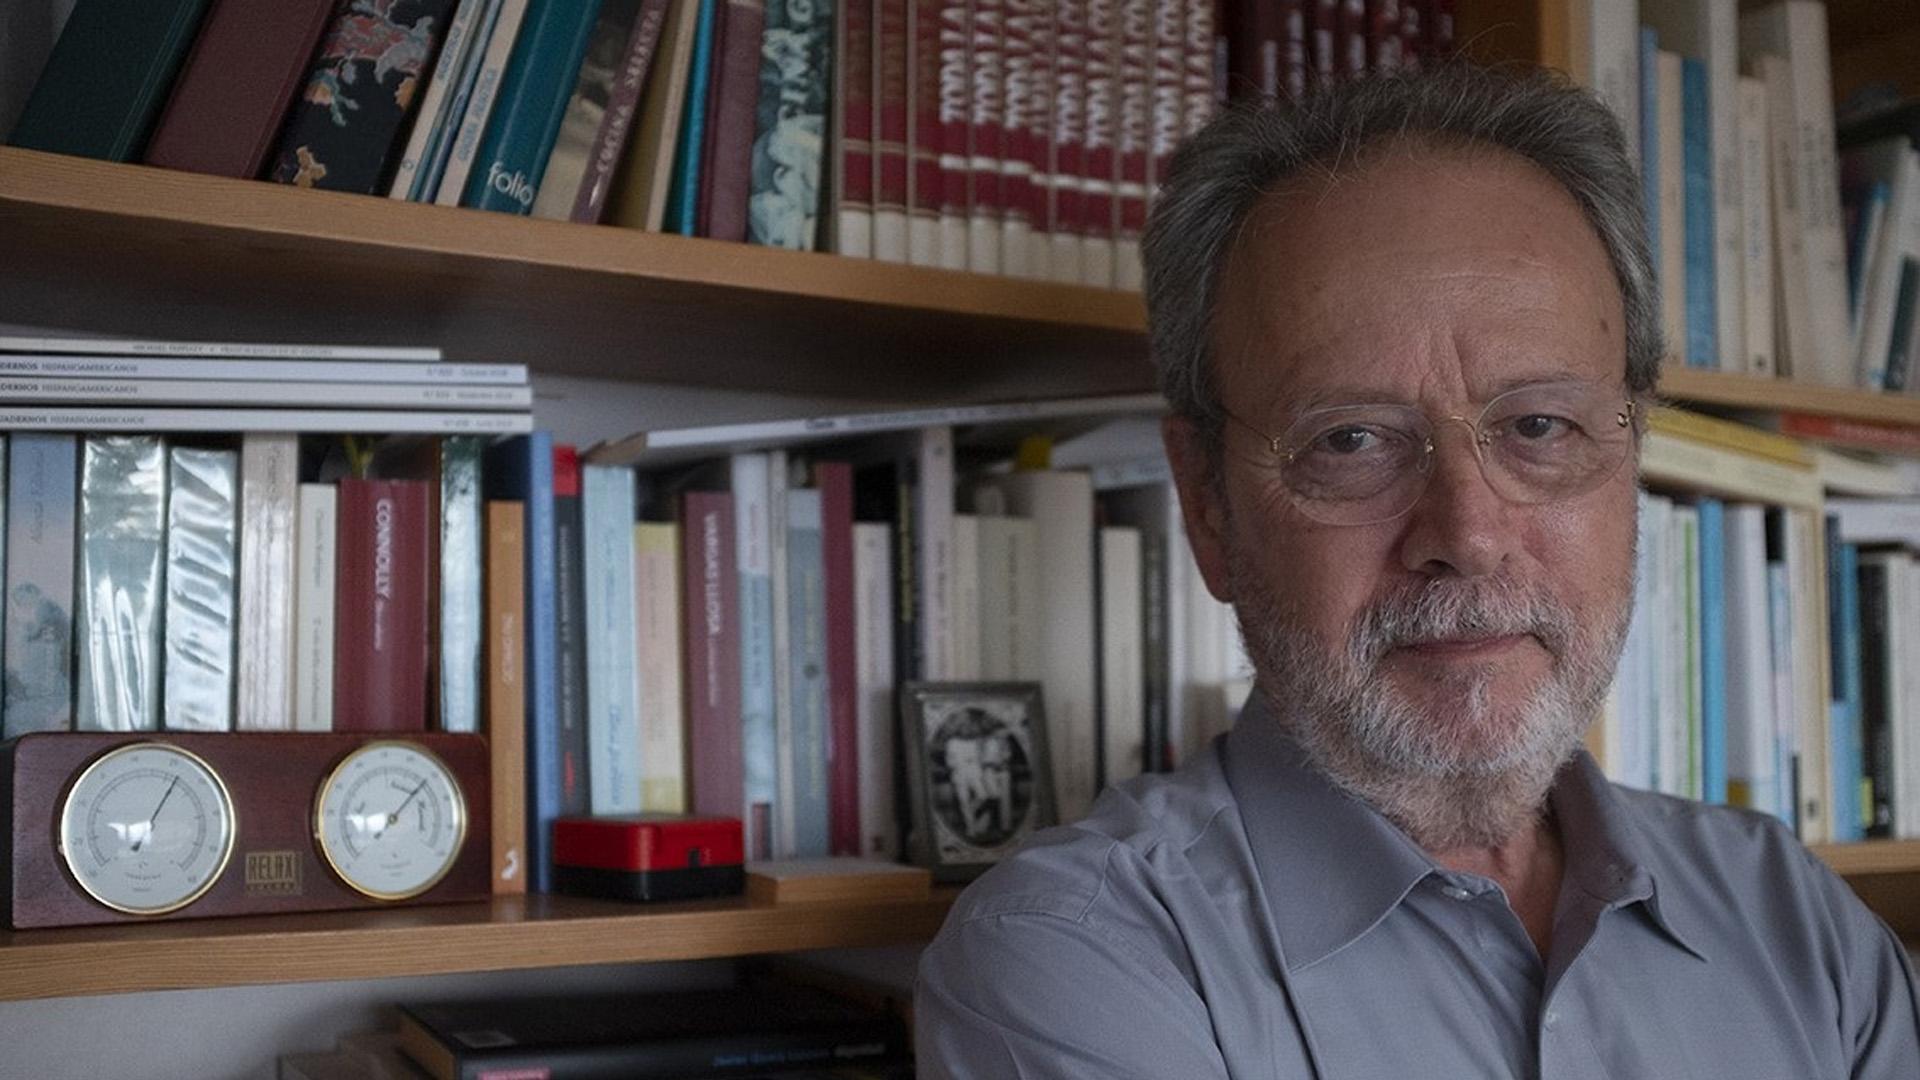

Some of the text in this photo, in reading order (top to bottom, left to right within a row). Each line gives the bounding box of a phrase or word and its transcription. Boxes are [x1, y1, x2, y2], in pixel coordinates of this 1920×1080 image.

[596, 8, 662, 173] COCINA SELECTA
[939, 48, 968, 124] TODA
[973, 50, 1002, 125] TODA
[1004, 57, 1031, 130] TODA
[1056, 73, 1083, 144] TODA
[1087, 78, 1113, 148] TODA
[1121, 83, 1148, 153] TODA
[1153, 87, 1181, 156] TODA
[486, 160, 535, 206] folio
[41, 363, 138, 373] HISPANOAMERICANOS
[41, 384, 138, 394] HISPANOAMERICANOS
[50, 416, 145, 425] HISPANOAMERICANOS
[375, 498, 392, 599] CONNOLLY
[703, 512, 721, 580] VARGAS
[704, 582, 722, 635] LLOSA
[248, 854, 293, 880] RELAX
